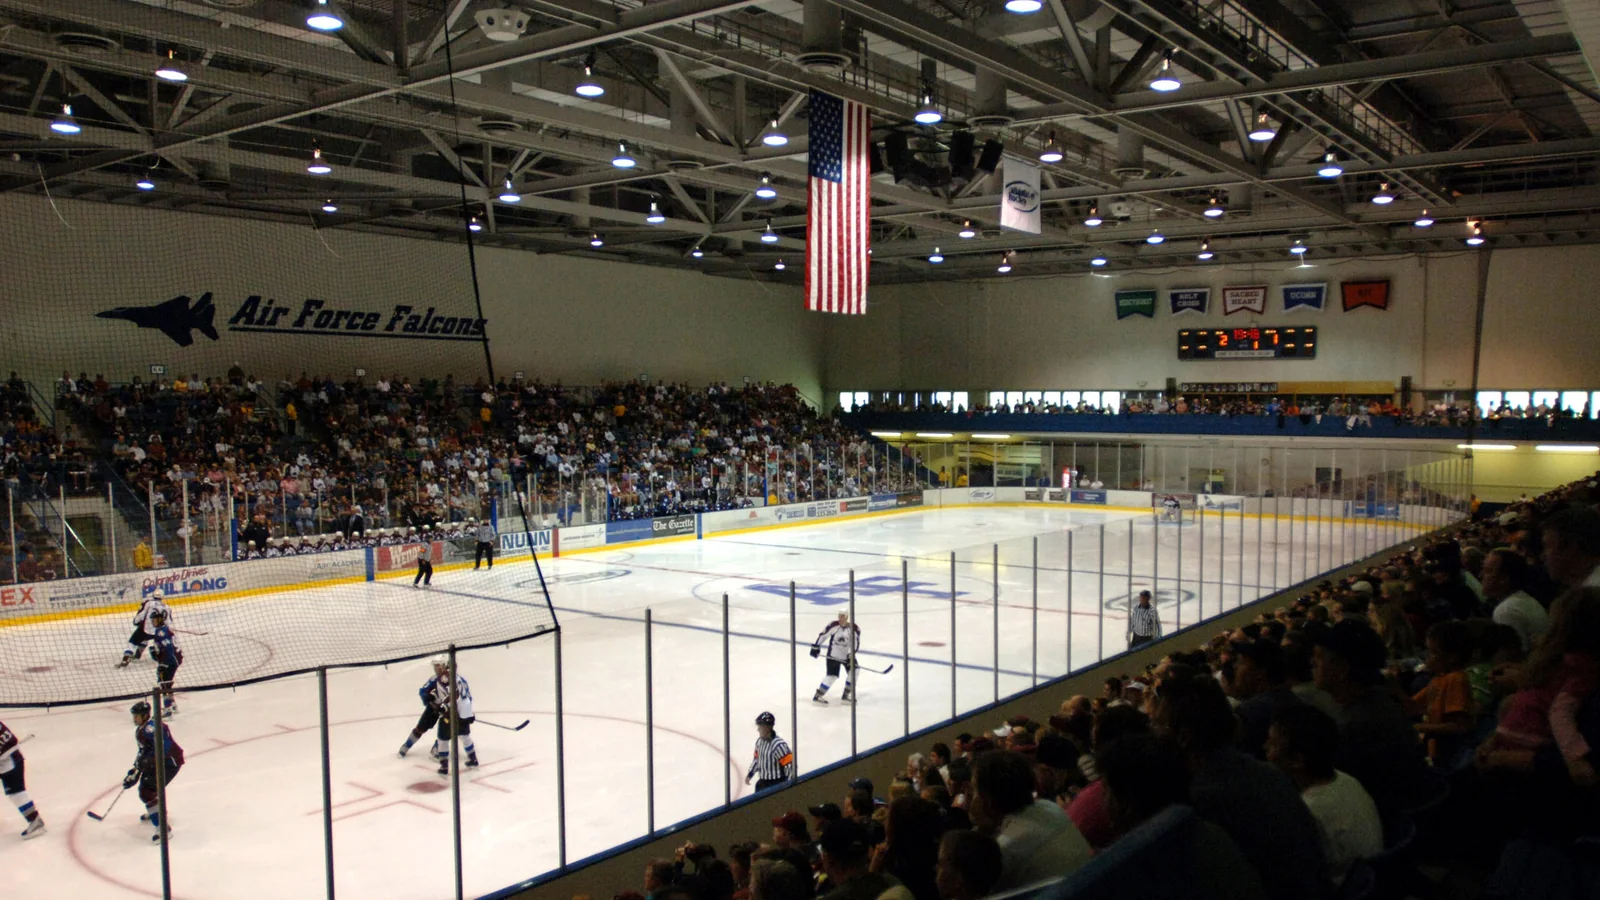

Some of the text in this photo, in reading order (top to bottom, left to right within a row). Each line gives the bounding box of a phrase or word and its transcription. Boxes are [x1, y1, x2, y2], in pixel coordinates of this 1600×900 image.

[228, 295, 488, 336] Air Force Falcons
[1219, 334, 1228, 346] 2
[652, 518, 694, 531] The Gazette
[501, 531, 550, 550] NUNN
[142, 567, 208, 588] Colorado Drives
[182, 577, 227, 593] LONG
